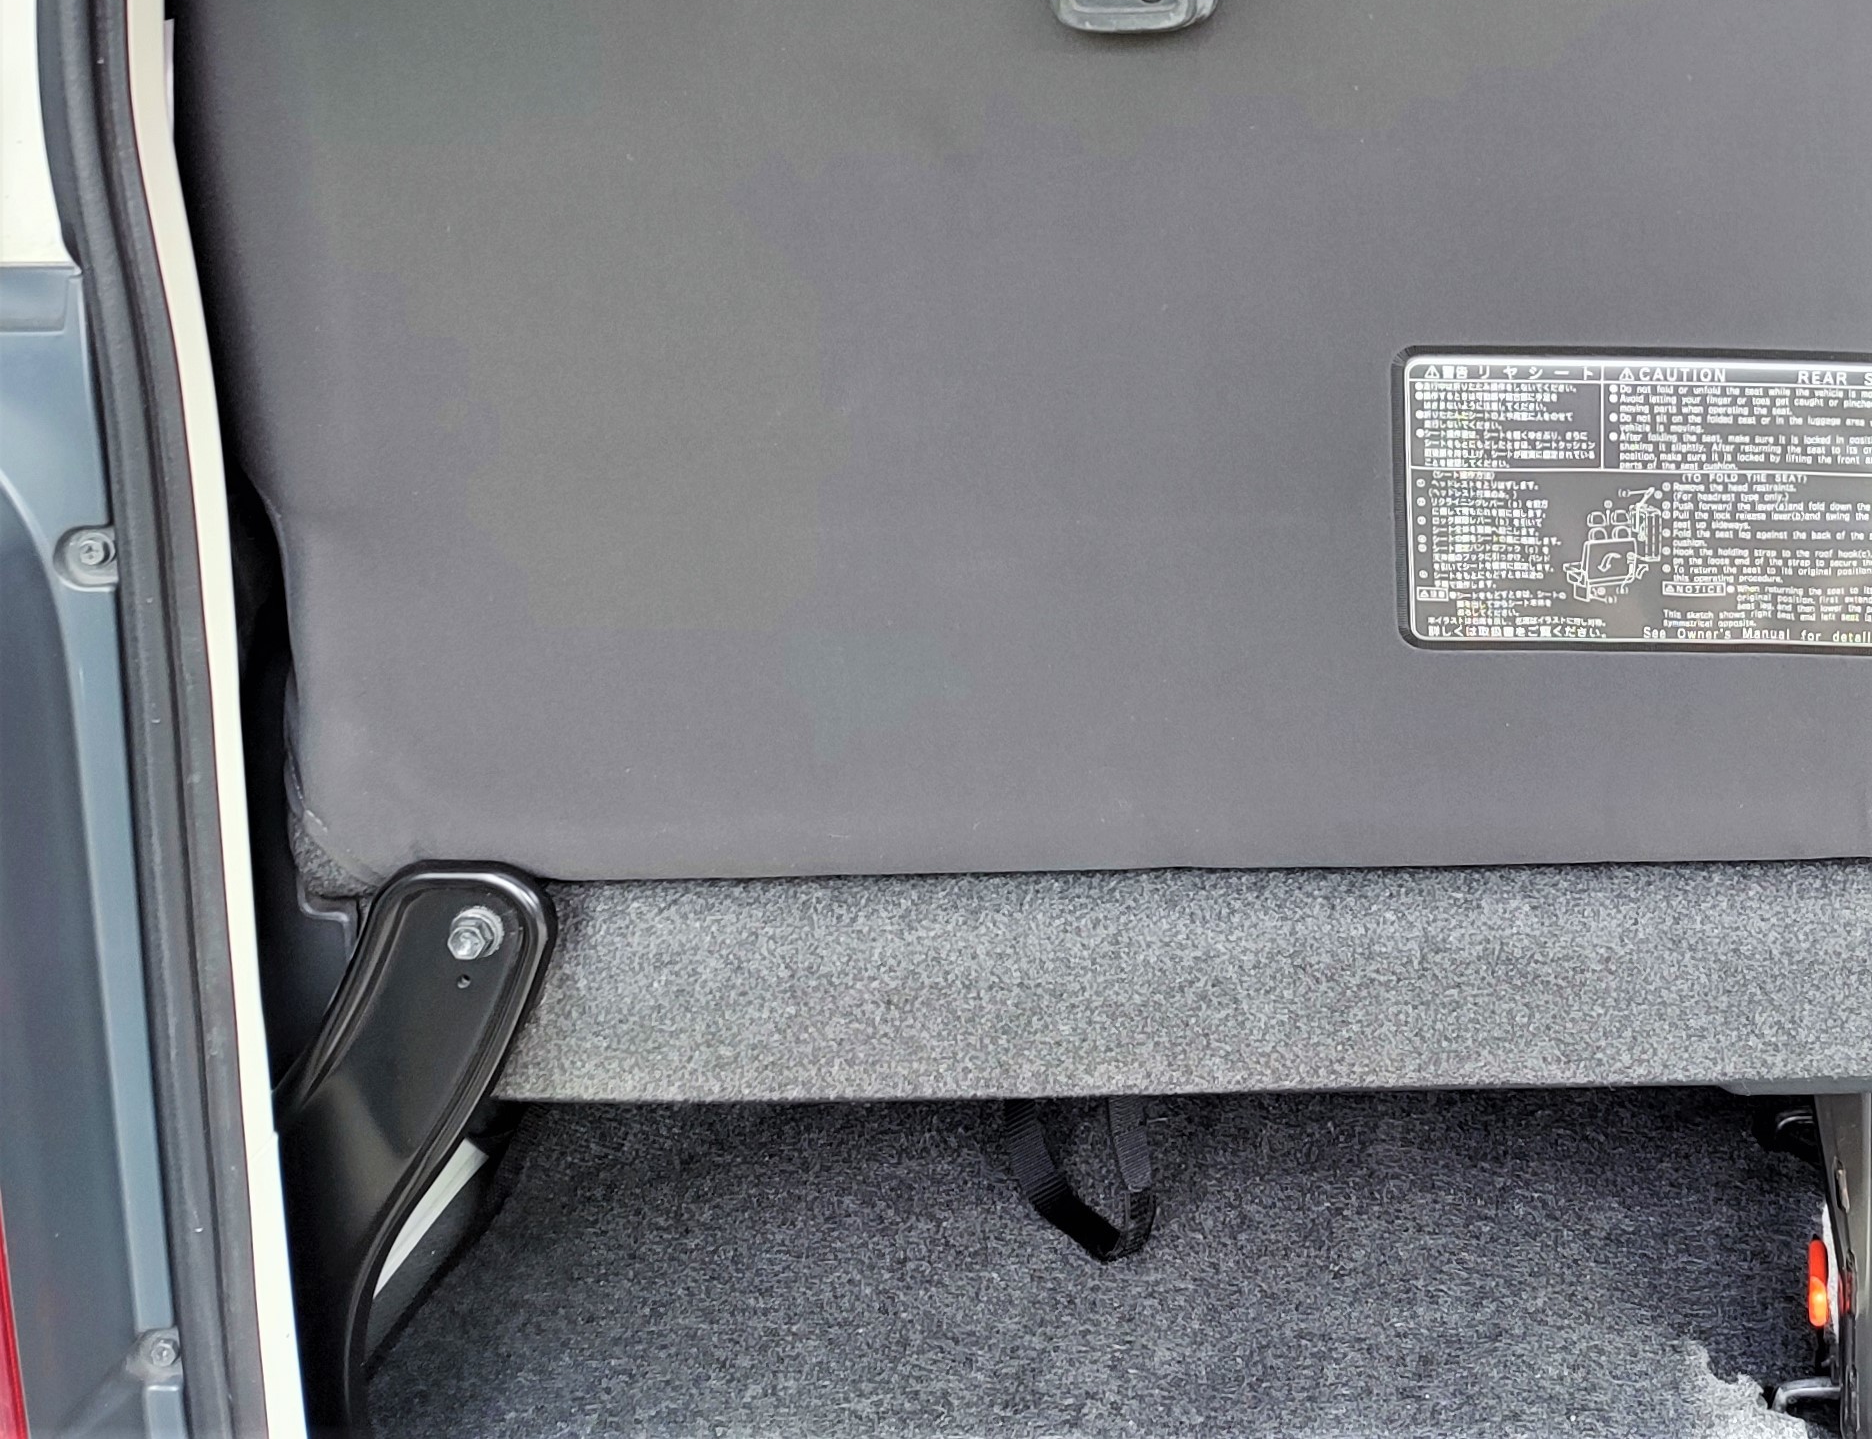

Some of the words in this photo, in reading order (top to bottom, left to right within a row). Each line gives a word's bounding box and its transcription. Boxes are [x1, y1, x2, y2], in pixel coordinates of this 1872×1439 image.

[1639, 368, 1725, 382] CAUTION
[1797, 371, 1847, 386] REAR
[1709, 473, 1738, 482] FOLD
[1746, 473, 1766, 482] THE
[1676, 585, 1722, 594] NOTICE
[1643, 626, 1666, 639] See
[1677, 627, 1731, 639] Owner's
[1742, 627, 1790, 639] Manual
[1800, 629, 1821, 641] for
